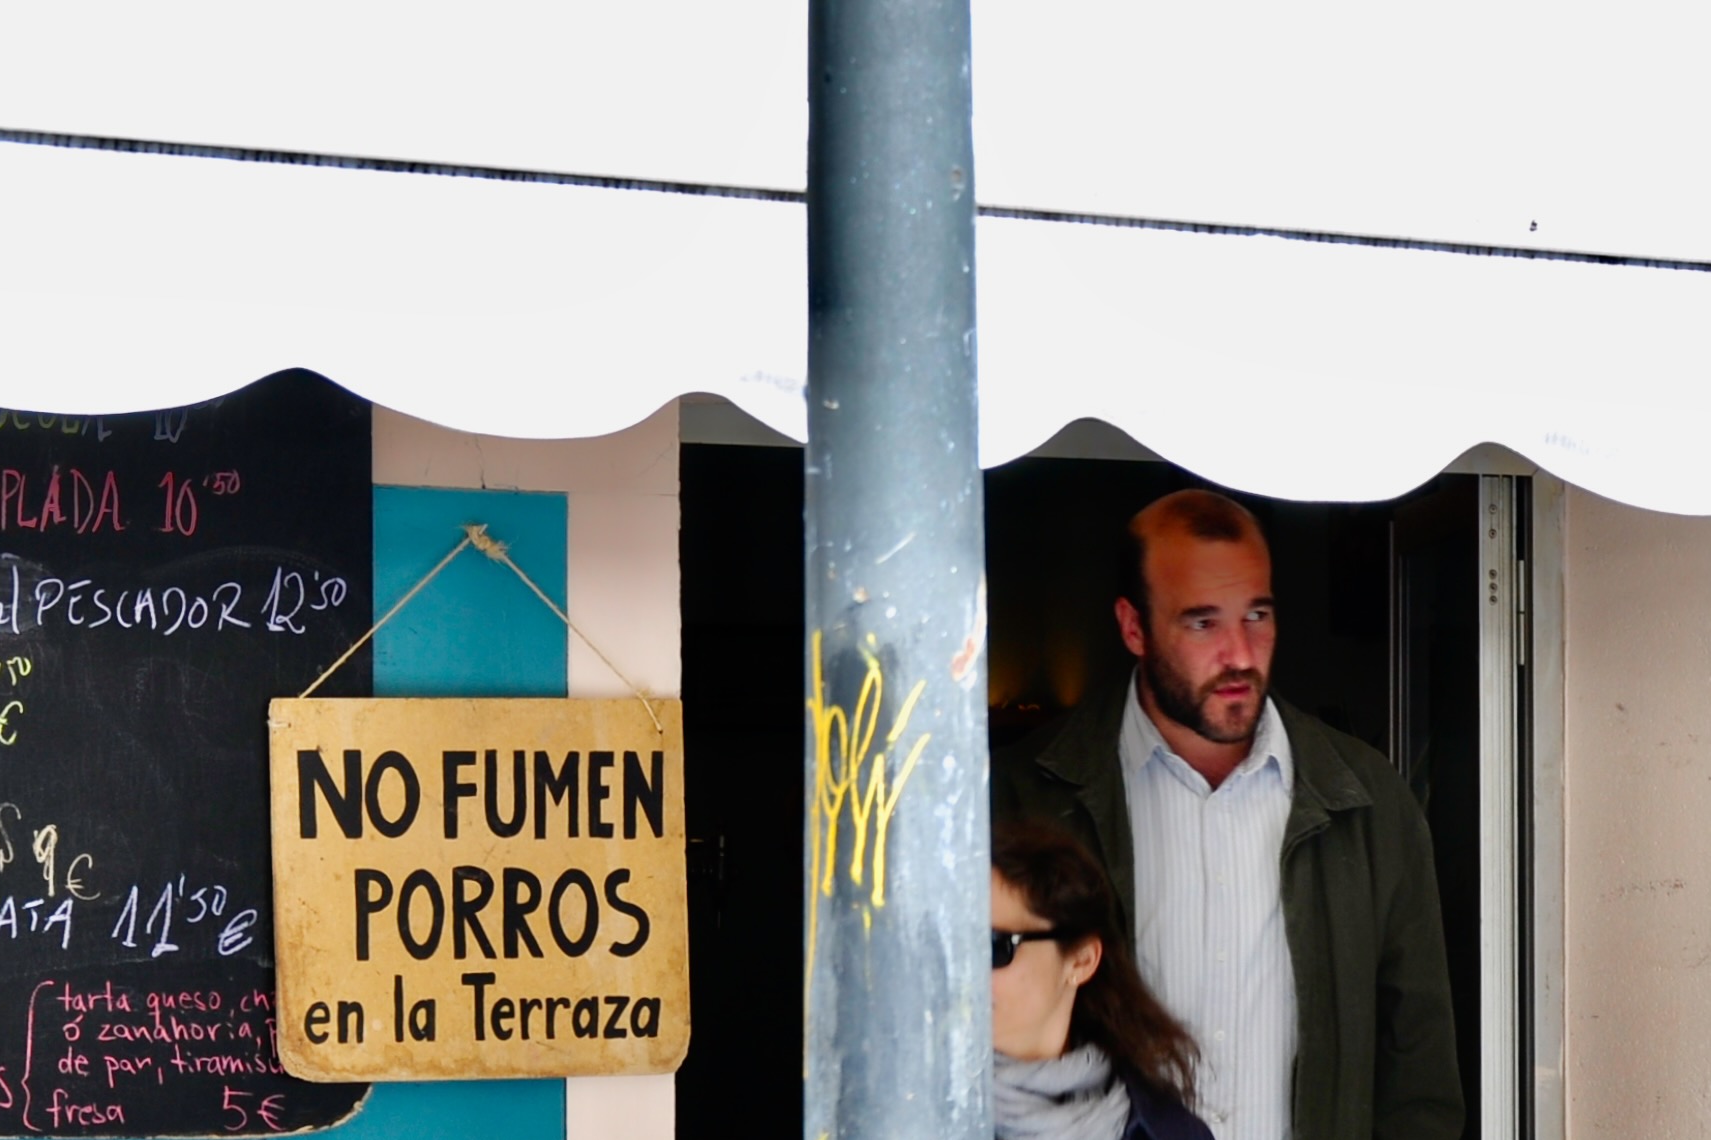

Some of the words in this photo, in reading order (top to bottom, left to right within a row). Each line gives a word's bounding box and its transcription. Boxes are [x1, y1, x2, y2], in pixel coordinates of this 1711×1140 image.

[34, 578, 252, 635] PESCADOR
[296, 749, 421, 840] NO
[442, 749, 665, 840] FUMEN
[353, 865, 651, 961] PORROS
[56, 979, 132, 1013] tarta
[303, 1000, 365, 1045] en
[393, 974, 437, 1043] la
[460, 971, 662, 1042] Terraza
[58, 1045, 90, 1077] de
[45, 1088, 126, 1129] fresa
